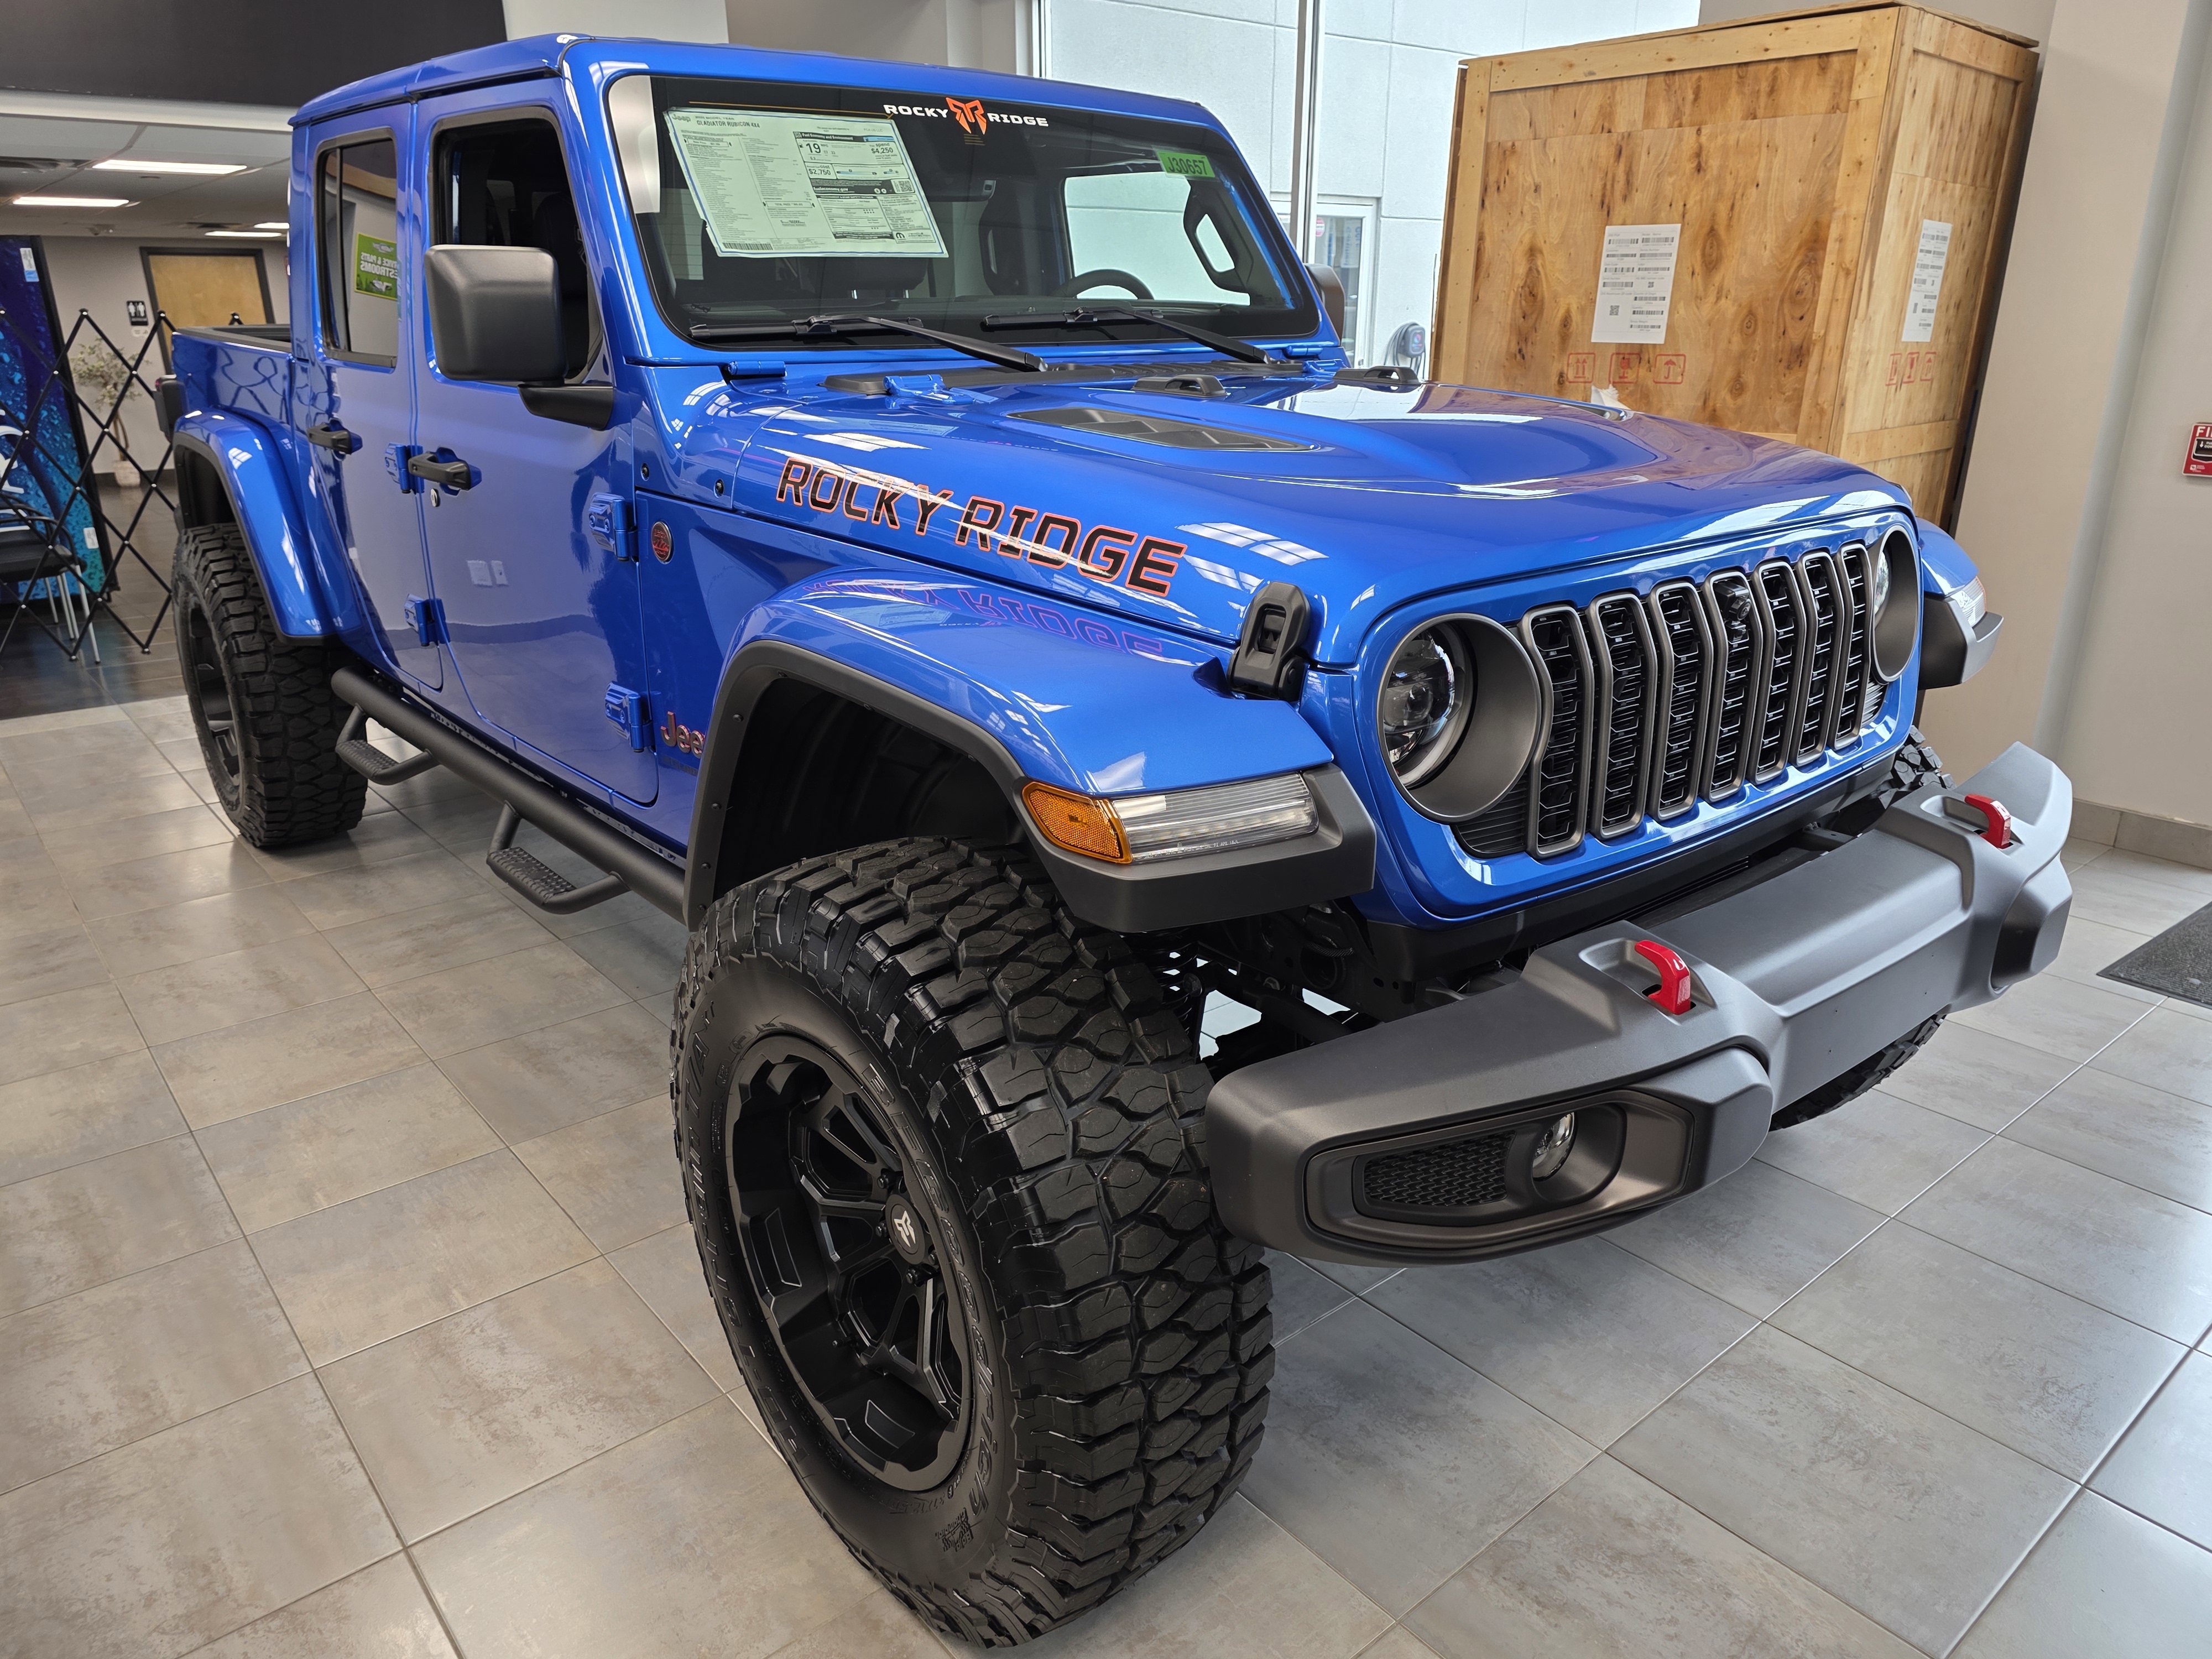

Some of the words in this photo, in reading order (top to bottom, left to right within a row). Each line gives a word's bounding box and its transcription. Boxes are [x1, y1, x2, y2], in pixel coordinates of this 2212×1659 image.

[672, 114, 691, 122] Jeep
[883, 105, 948, 118] ROCKY
[987, 112, 1048, 127] RIDGE
[806, 143, 821, 154] 19
[1167, 156, 1208, 175] J30657
[2196, 426, 2212, 438] FI
[776, 457, 954, 536] ROCKY
[955, 496, 1188, 598] RIDGE
[660, 711, 705, 759] Jee
[862, 1063, 998, 1516] BFGoodrich
